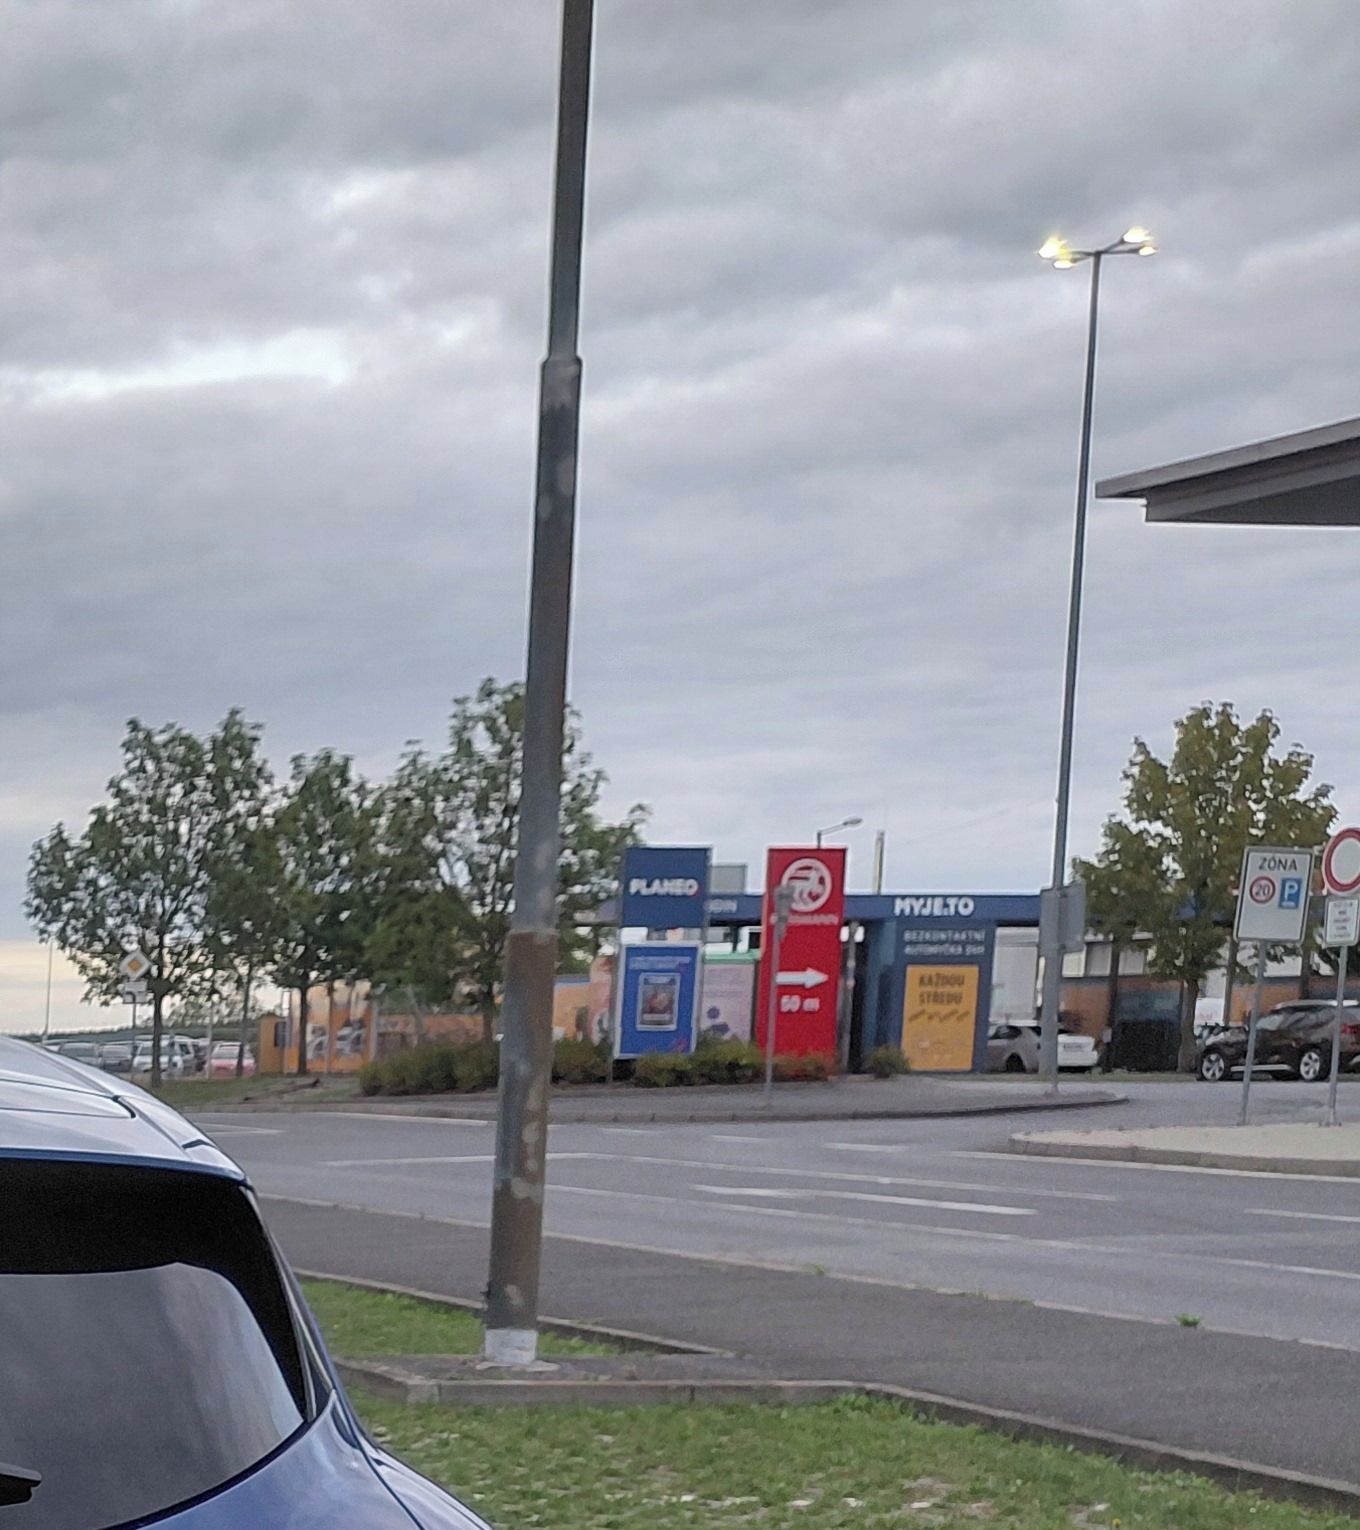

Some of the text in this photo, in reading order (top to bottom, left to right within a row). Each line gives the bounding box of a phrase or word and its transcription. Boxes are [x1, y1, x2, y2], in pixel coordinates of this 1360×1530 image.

[1258, 854, 1298, 872] ZÓNA
[629, 878, 699, 896] PLANEO
[1255, 880, 1298, 901] 20 P
[893, 897, 975, 917] MYJE.TO
